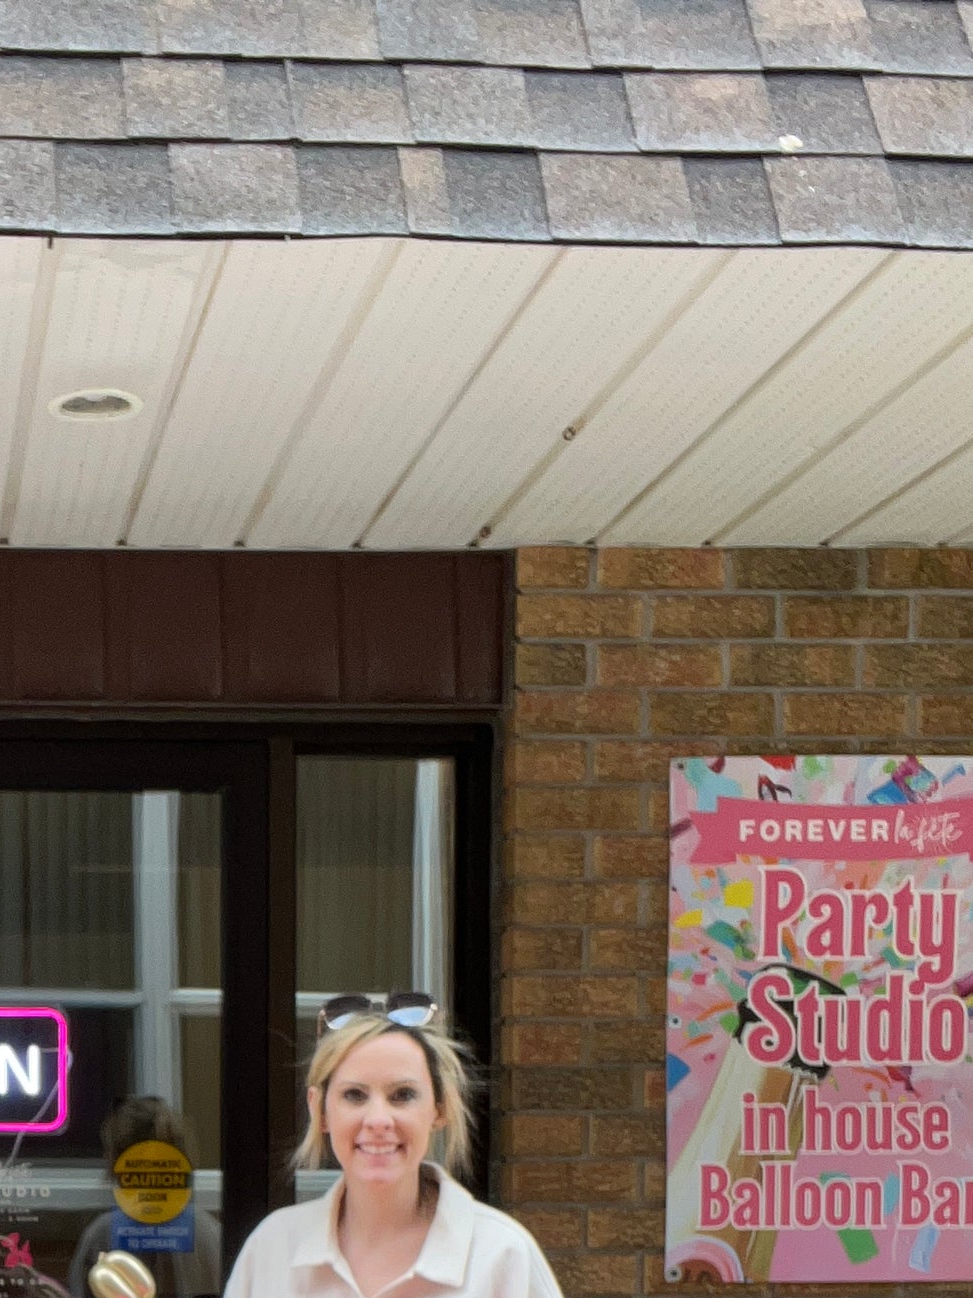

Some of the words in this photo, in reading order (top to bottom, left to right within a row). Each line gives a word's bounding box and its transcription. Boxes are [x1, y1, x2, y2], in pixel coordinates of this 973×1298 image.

[738, 818, 890, 843] FOREVER
[760, 867, 961, 995] Party
[746, 973, 967, 1064] Studio
[741, 1091, 788, 1153] in
[802, 1087, 950, 1153] house
[121, 1173, 184, 1187] CAUTION
[698, 1162, 885, 1229] Balloon
